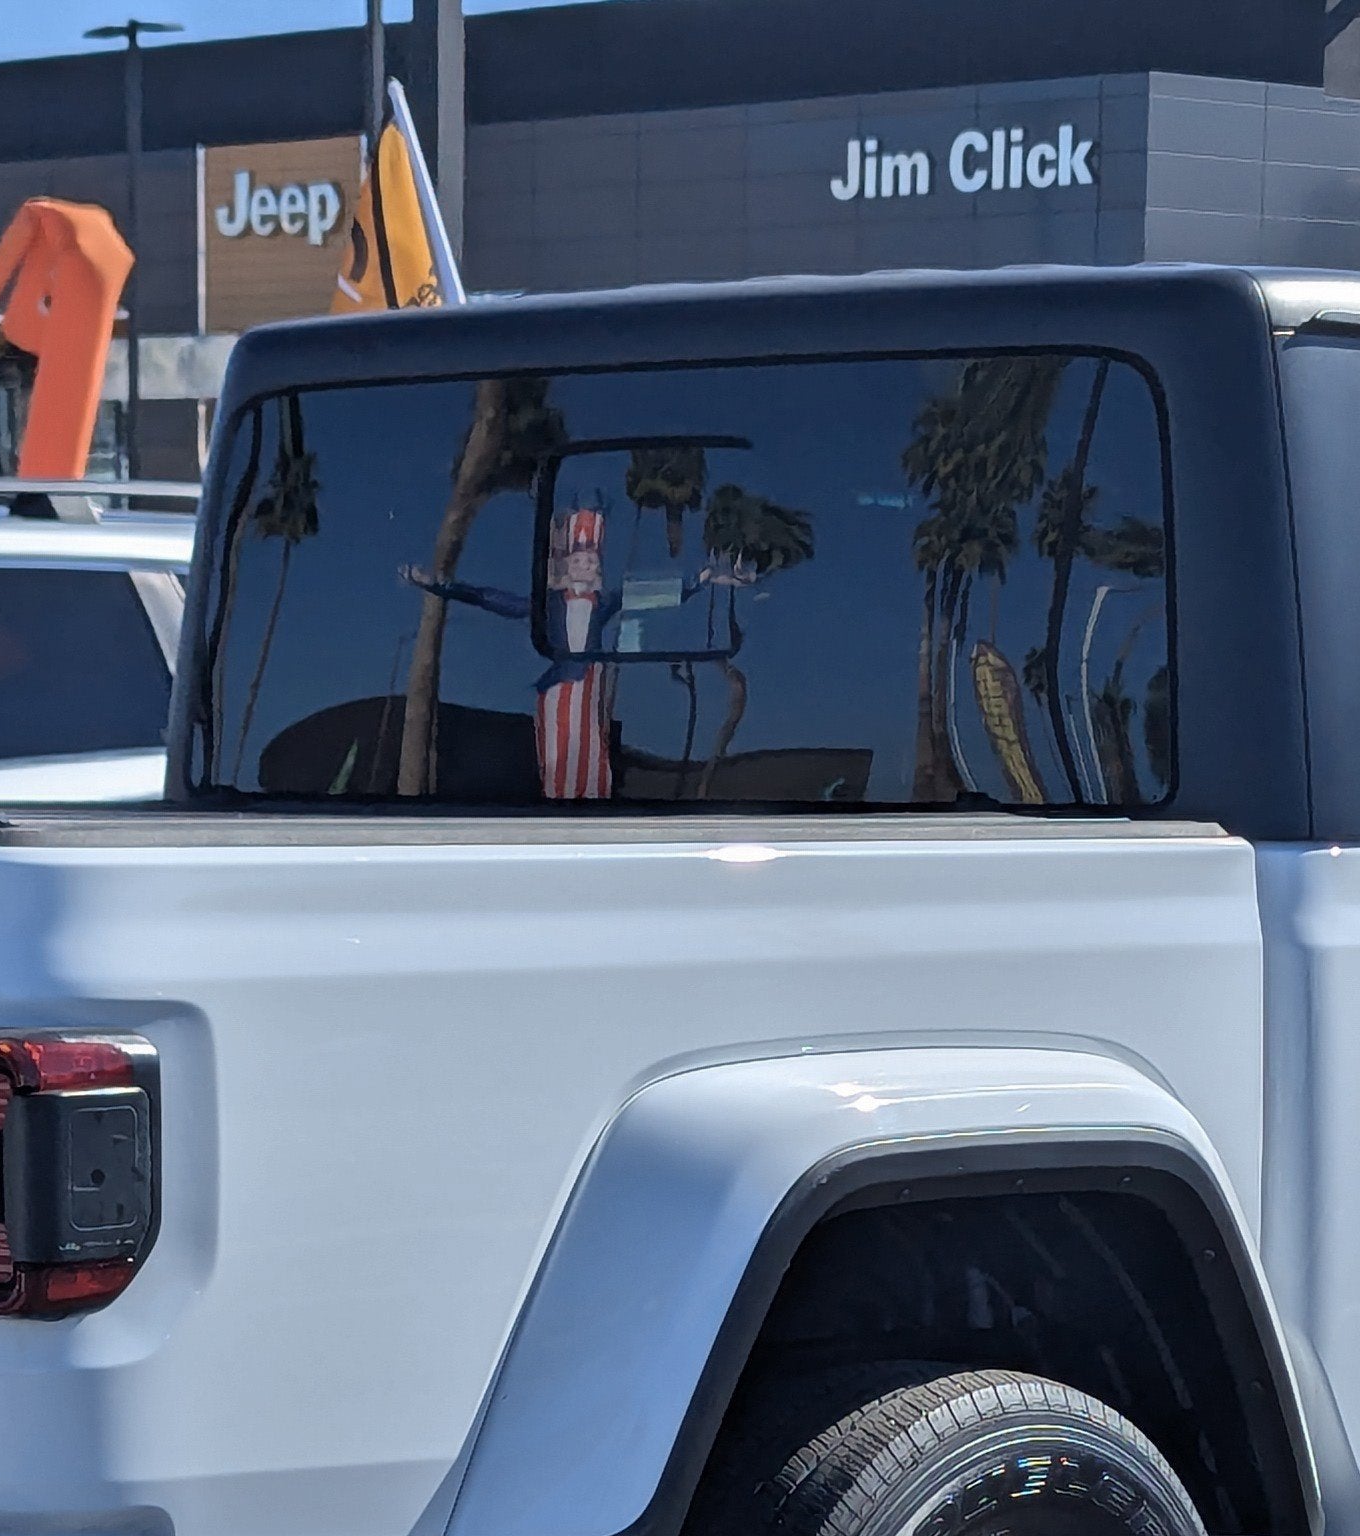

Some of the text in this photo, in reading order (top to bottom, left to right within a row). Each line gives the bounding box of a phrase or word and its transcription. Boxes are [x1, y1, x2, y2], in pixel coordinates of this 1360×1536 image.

[830, 123, 1094, 200] Jim Click
[215, 169, 341, 246] Jeep
